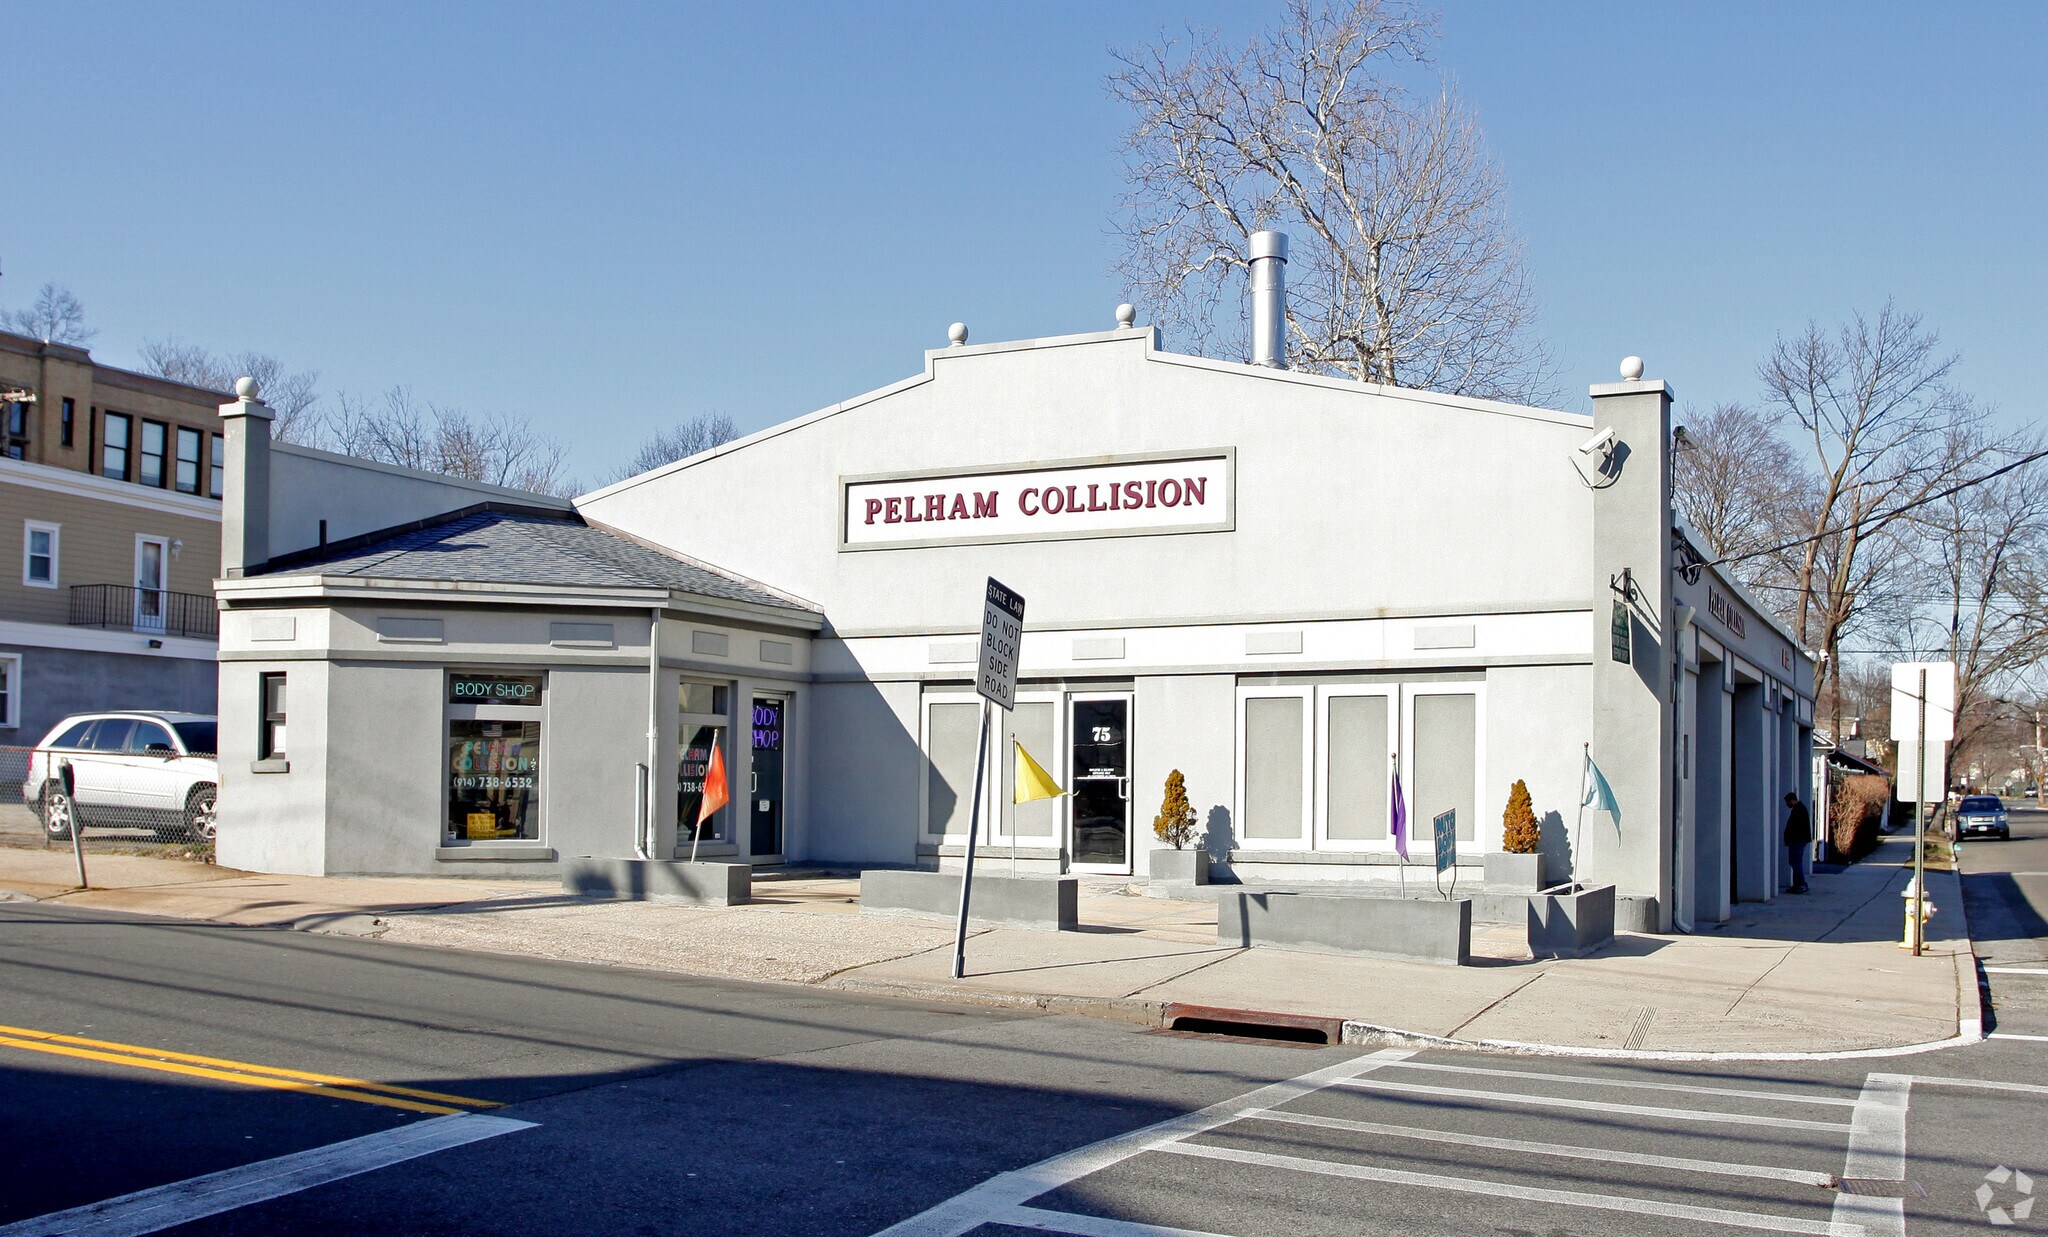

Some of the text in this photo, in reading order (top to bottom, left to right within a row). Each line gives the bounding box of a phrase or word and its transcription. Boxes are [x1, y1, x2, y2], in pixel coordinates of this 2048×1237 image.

[865, 476, 1207, 524] PELHAM COLLISION
[988, 584, 1023, 617] STATE LAW
[986, 610, 1019, 642] DO NOT
[986, 632, 1015, 661] BLOCK
[988, 655, 1009, 679] SIDE
[455, 682, 535, 697] BODY SHOP
[984, 674, 1008, 699] ROAD
[1091, 726, 1111, 742] 75
[461, 740, 522, 756] PELHAM
[452, 757, 528, 771] COLLISION
[453, 776, 533, 788] (914) 738-6532
